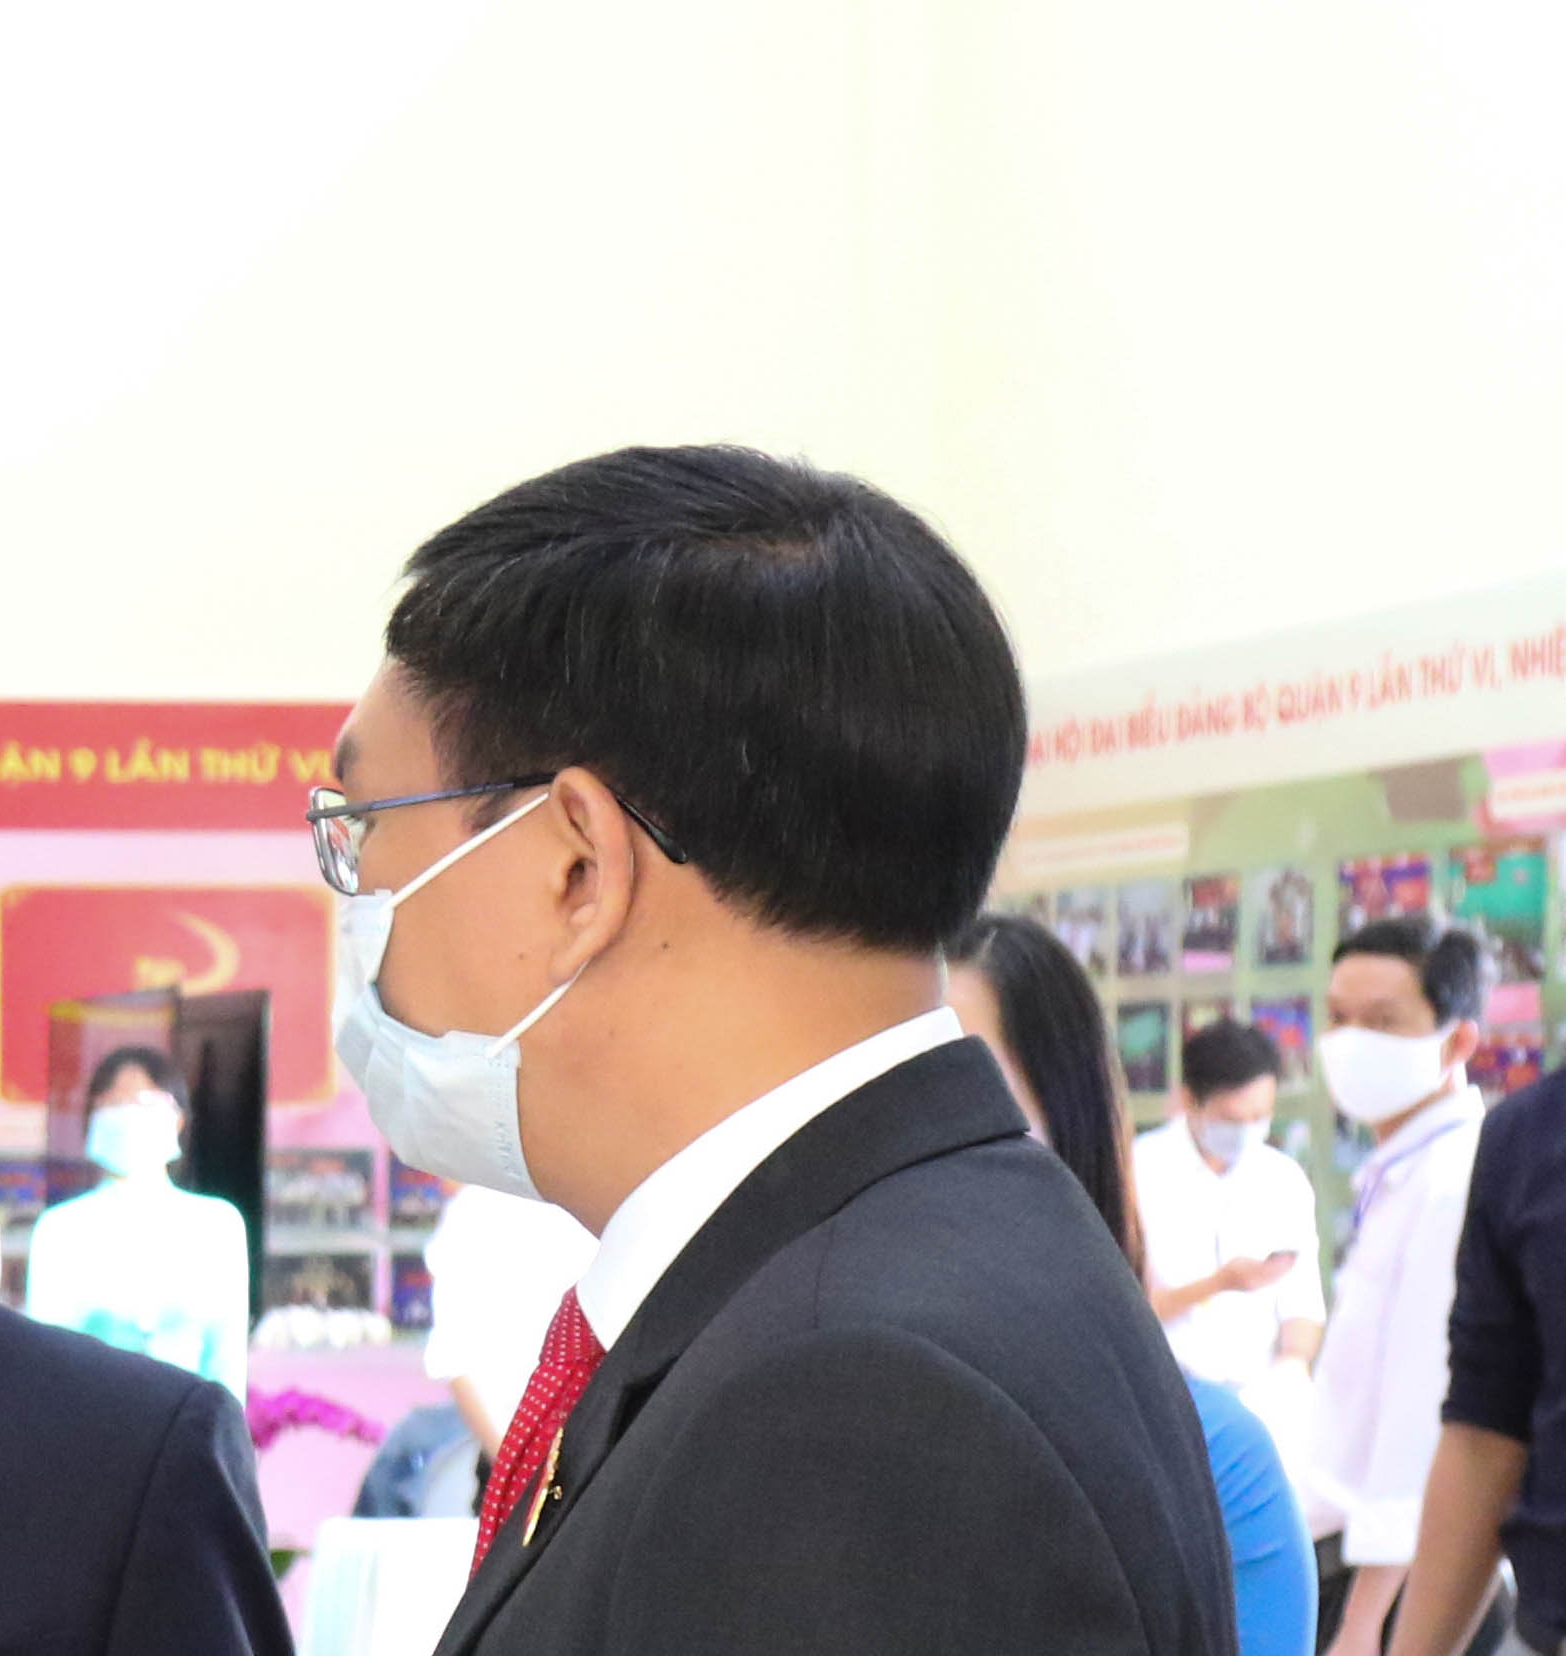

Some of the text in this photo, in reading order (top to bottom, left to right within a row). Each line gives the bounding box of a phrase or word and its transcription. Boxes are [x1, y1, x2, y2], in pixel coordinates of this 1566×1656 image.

[71, 746, 97, 783] 9
[103, 736, 191, 784] LẦN
[199, 742, 280, 784] THỨ
